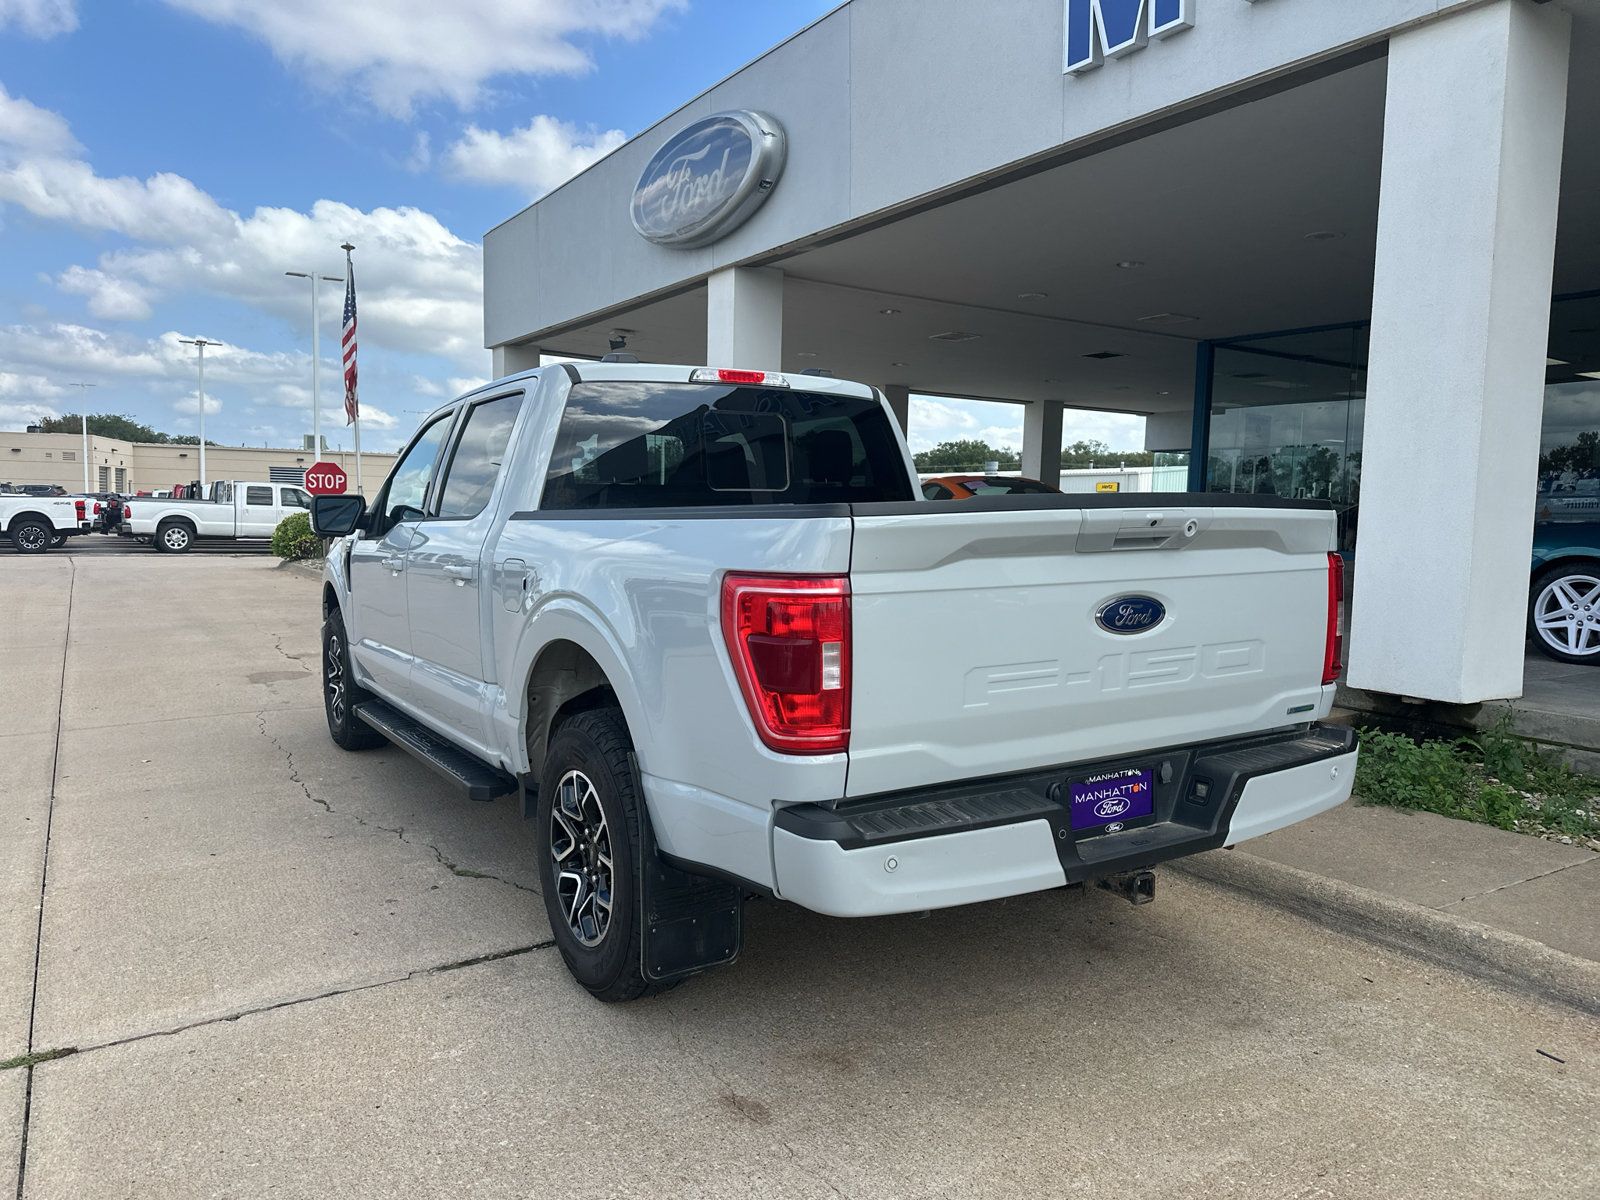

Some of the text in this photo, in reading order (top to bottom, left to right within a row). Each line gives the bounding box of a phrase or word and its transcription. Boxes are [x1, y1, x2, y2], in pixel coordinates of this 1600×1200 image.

[660, 143, 731, 219] Ford
[308, 473, 345, 489] STOP
[1114, 604, 1153, 626] Ford
[963, 638, 1267, 707] F-150
[1088, 769, 1139, 783] MANHATTN
[1075, 782, 1148, 803] MANHATTN
[1100, 799, 1124, 815] Ford
